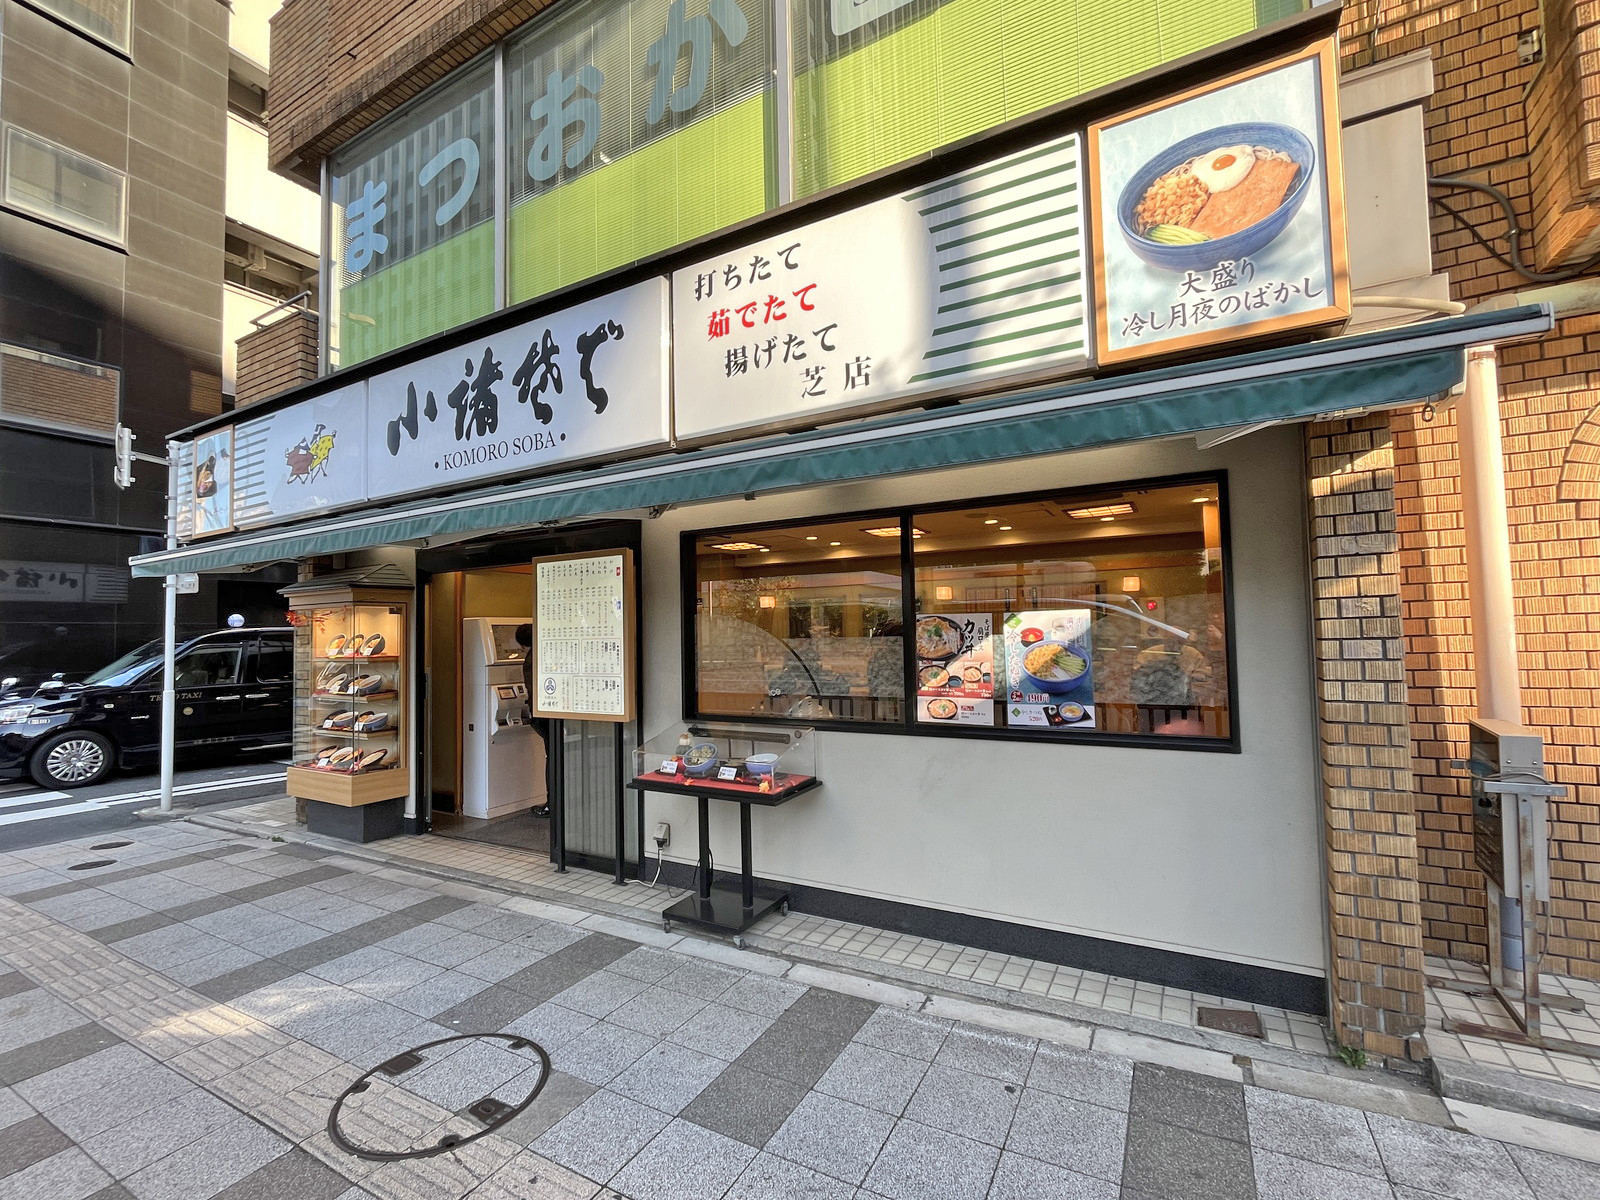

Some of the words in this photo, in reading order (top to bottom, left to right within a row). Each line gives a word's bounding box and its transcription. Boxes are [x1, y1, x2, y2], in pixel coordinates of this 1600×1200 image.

[694, 243, 801, 301] 打ちたて
[1180, 259, 1255, 298] 大盛り
[707, 283, 817, 341] 茹でたて
[1122, 278, 1324, 337] 冷し月夜のばかし
[724, 323, 838, 378] 揚げたて
[799, 356, 872, 399] 芝店
[443, 440, 509, 471] KOMORO
[513, 430, 556, 455] SOBA
[960, 618, 978, 658] カツ丼
